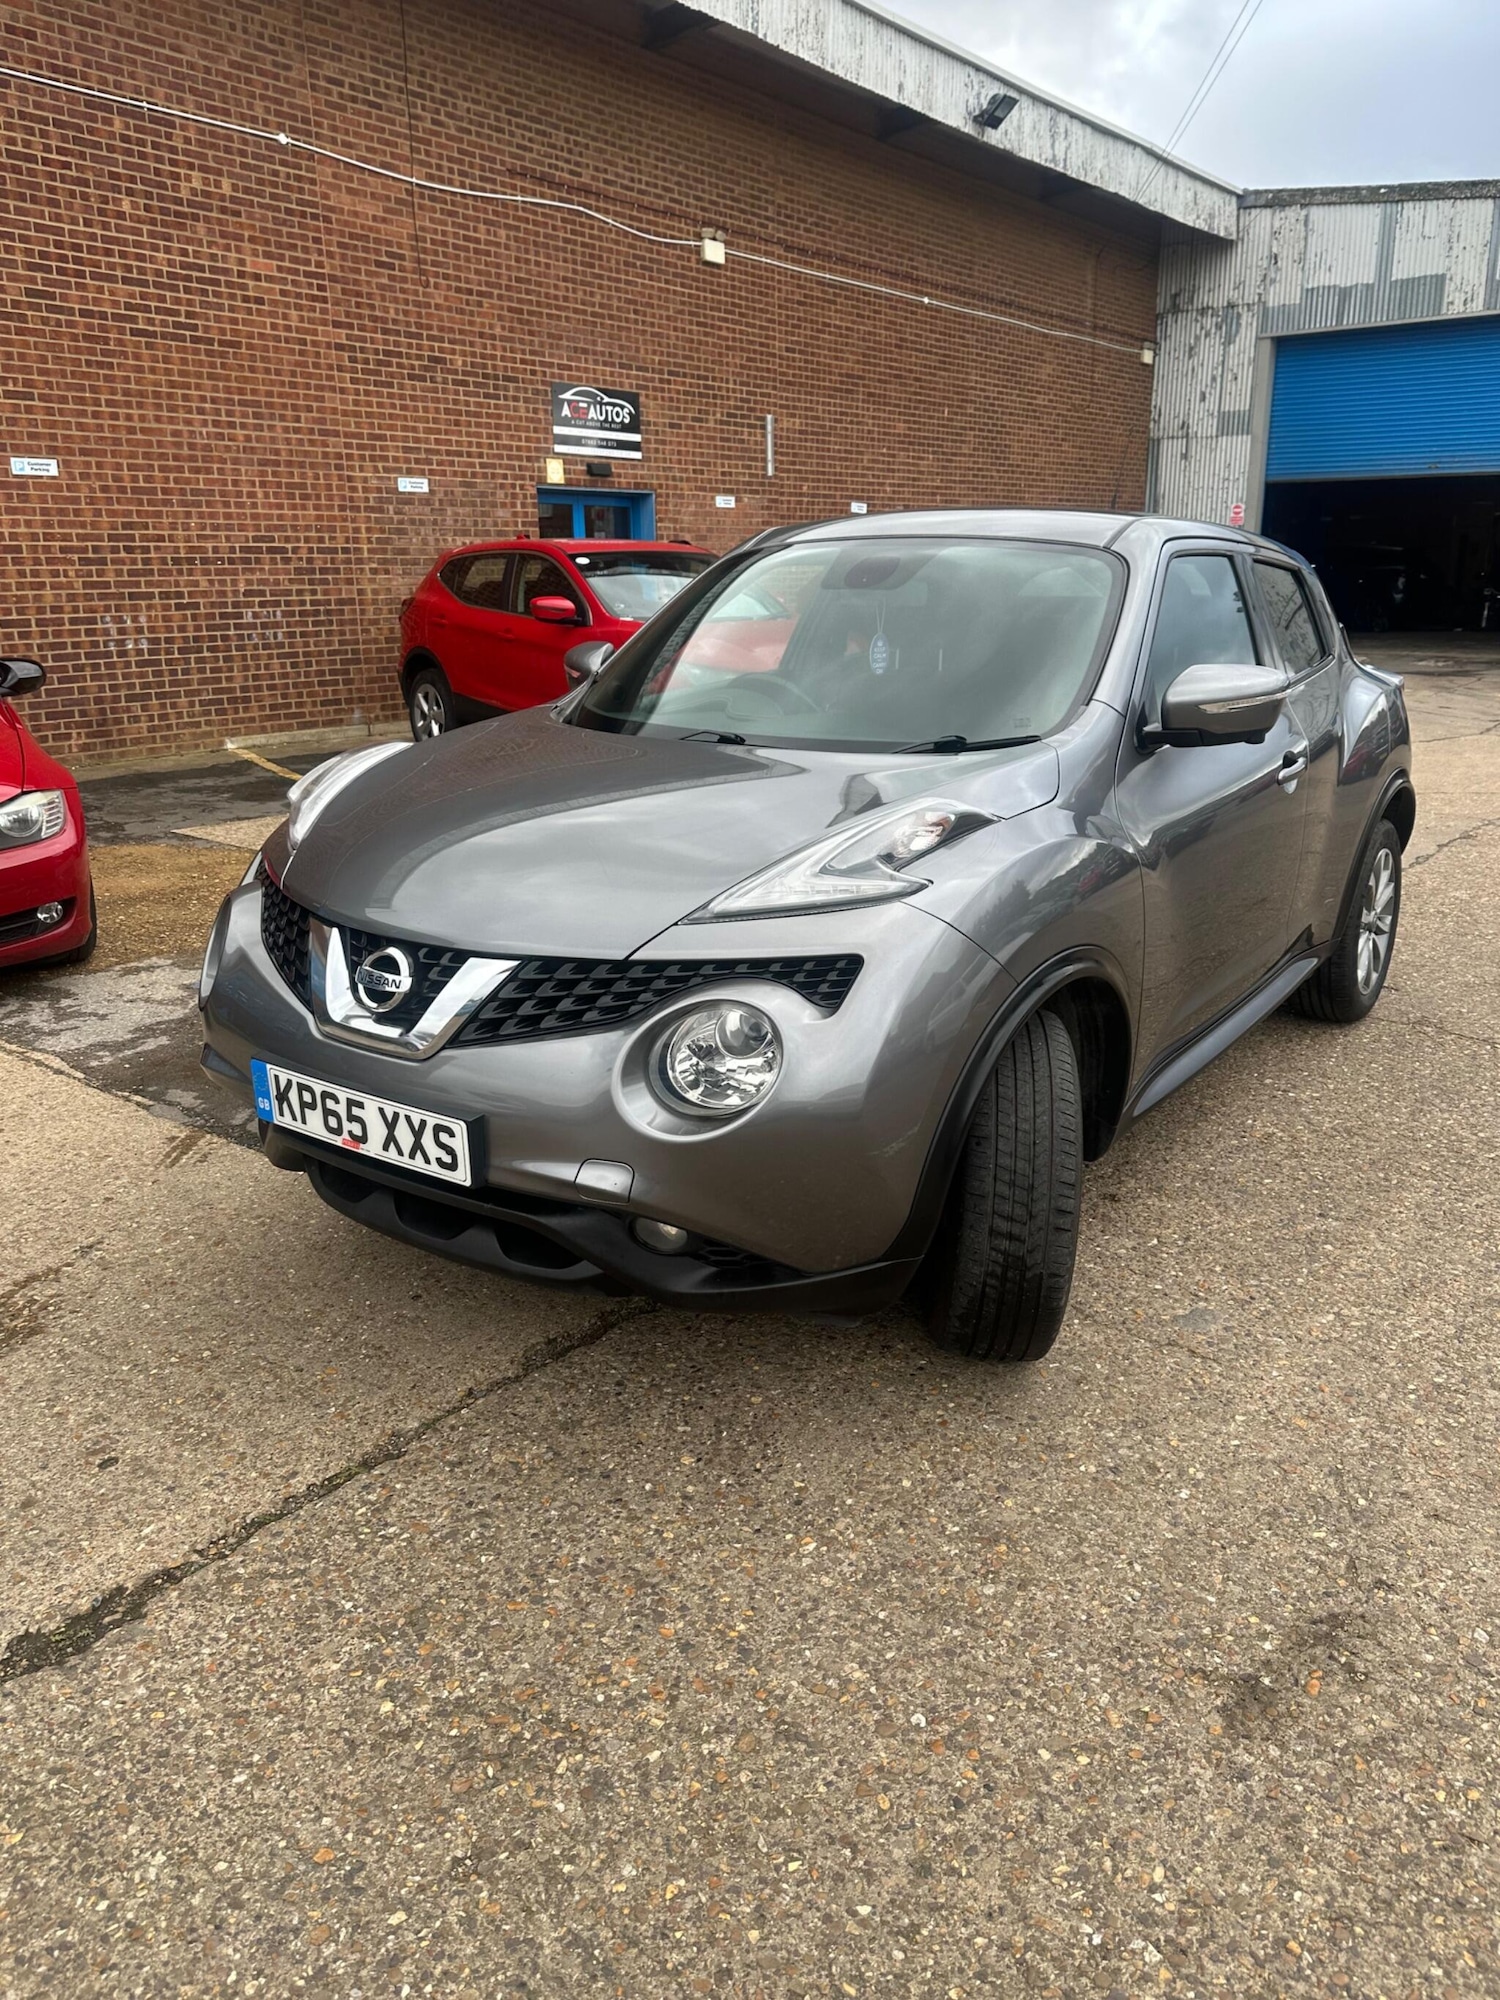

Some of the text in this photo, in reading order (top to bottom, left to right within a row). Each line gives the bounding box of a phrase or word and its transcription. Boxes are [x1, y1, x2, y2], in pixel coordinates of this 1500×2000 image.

[357, 968, 402, 989] NISSAN
[258, 1097, 270, 1111] GB
[274, 1074, 458, 1172] KP65 XXS
